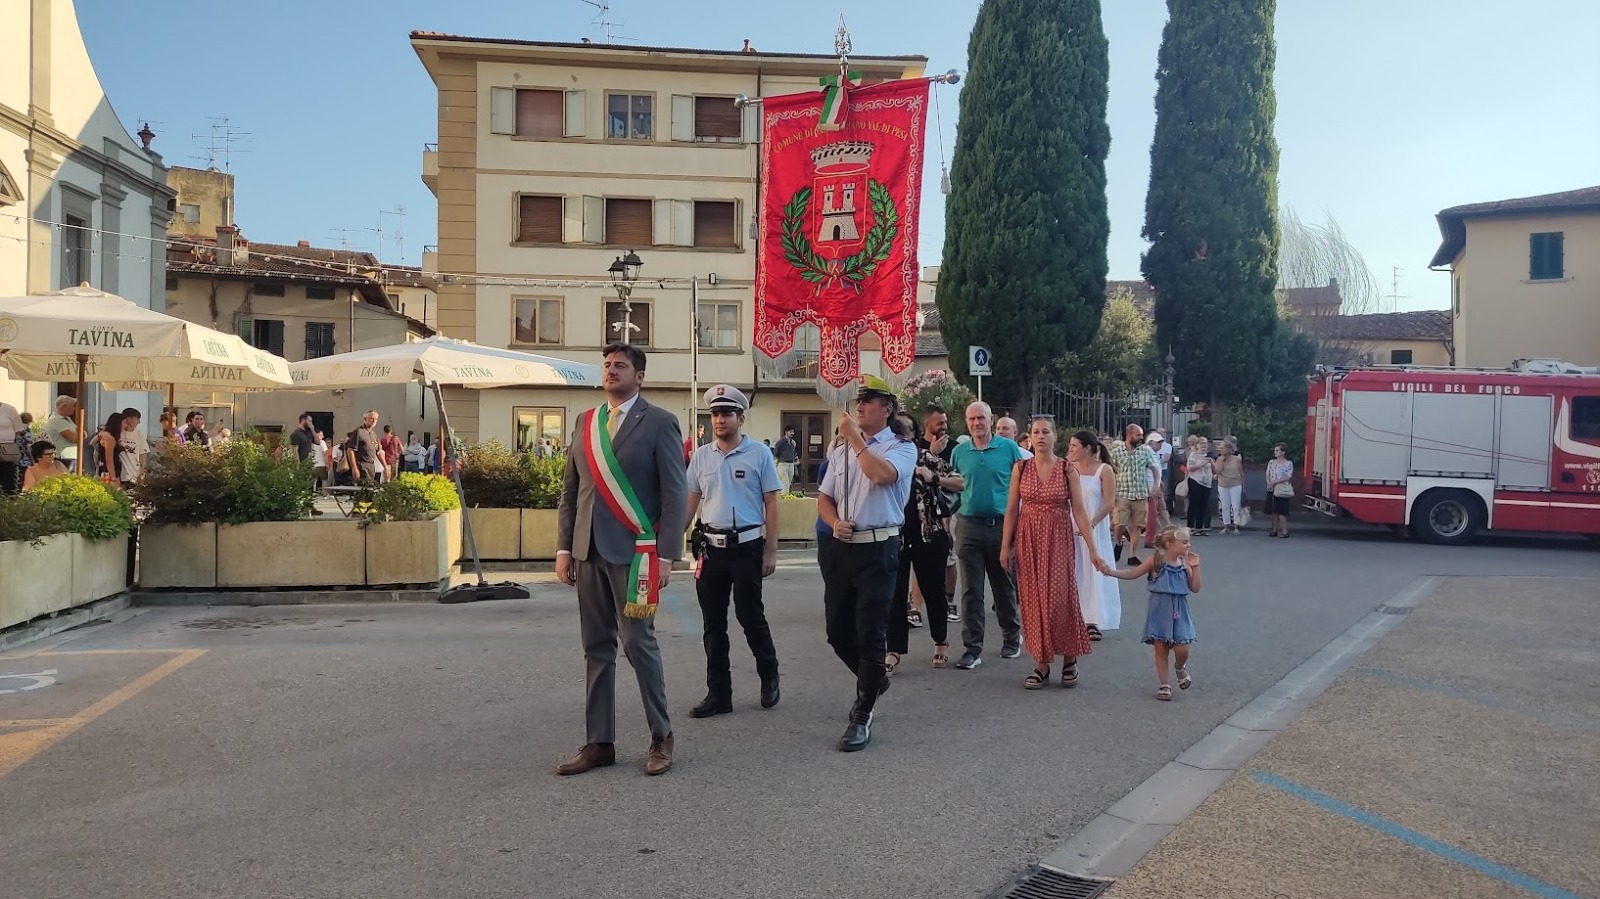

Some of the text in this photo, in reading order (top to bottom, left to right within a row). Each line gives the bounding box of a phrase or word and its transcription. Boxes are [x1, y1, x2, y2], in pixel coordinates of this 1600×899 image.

[881, 123, 891, 134] DI
[891, 125, 908, 141] PESA
[773, 131, 803, 153] COMUNE
[804, 128, 813, 138] DI
[68, 328, 135, 349] TAVINA
[360, 366, 392, 378] TAVINA
[451, 367, 494, 378] TAVINA
[551, 369, 586, 381] TAVINA
[1392, 382, 1520, 395] VIGILI DEL FUOCO
